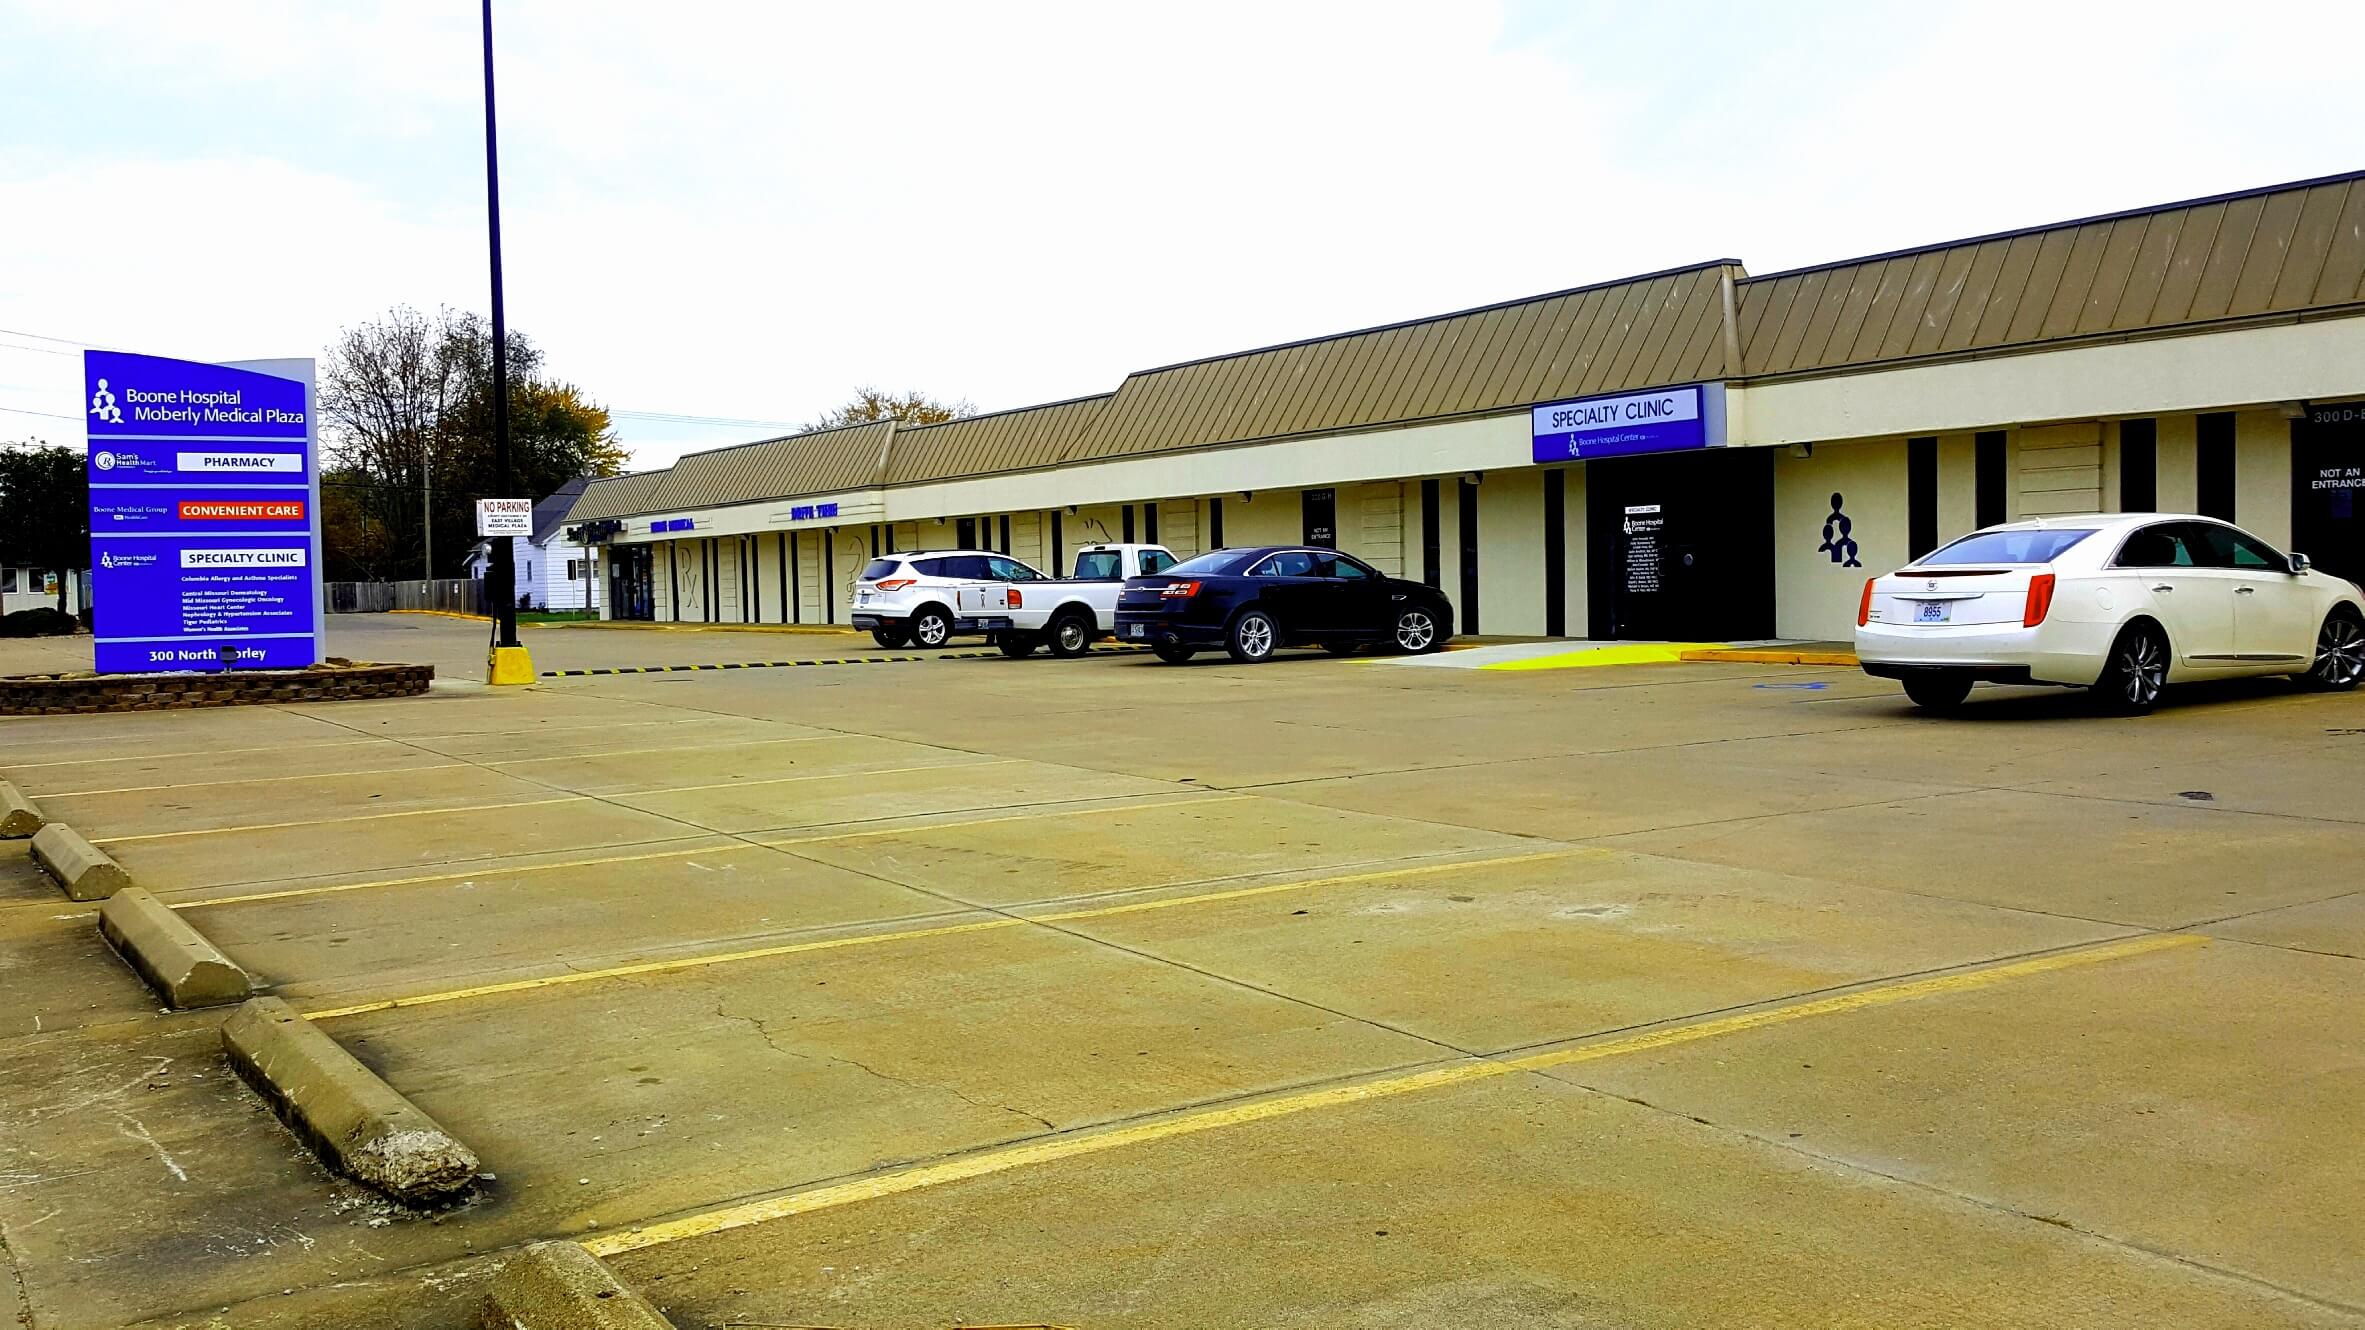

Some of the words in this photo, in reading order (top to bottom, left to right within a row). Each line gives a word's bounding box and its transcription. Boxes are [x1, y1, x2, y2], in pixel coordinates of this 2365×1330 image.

[126, 388, 177, 403] Boone
[180, 389, 241, 408] Hospital
[135, 406, 201, 426] Moberly
[204, 407, 262, 423] Medical
[266, 409, 304, 423] Plaza
[1552, 405, 1618, 428] SPECIALTY
[1625, 399, 1673, 419] CLINIC
[2314, 411, 2340, 423] 300
[203, 457, 275, 468] PHARMACY
[2320, 468, 2341, 478] NOT
[2345, 468, 2360, 477] AN
[182, 506, 264, 517] CONVENIENT
[266, 506, 299, 516] CARE
[484, 502, 495, 512] NO
[497, 501, 529, 512] PARKING
[189, 553, 255, 564] SPECIALTY
[257, 553, 298, 563] CLINIC
[1923, 606, 1941, 617] 8955
[149, 650, 174, 661] 300
[178, 648, 216, 660] North
[222, 647, 266, 661] orley
